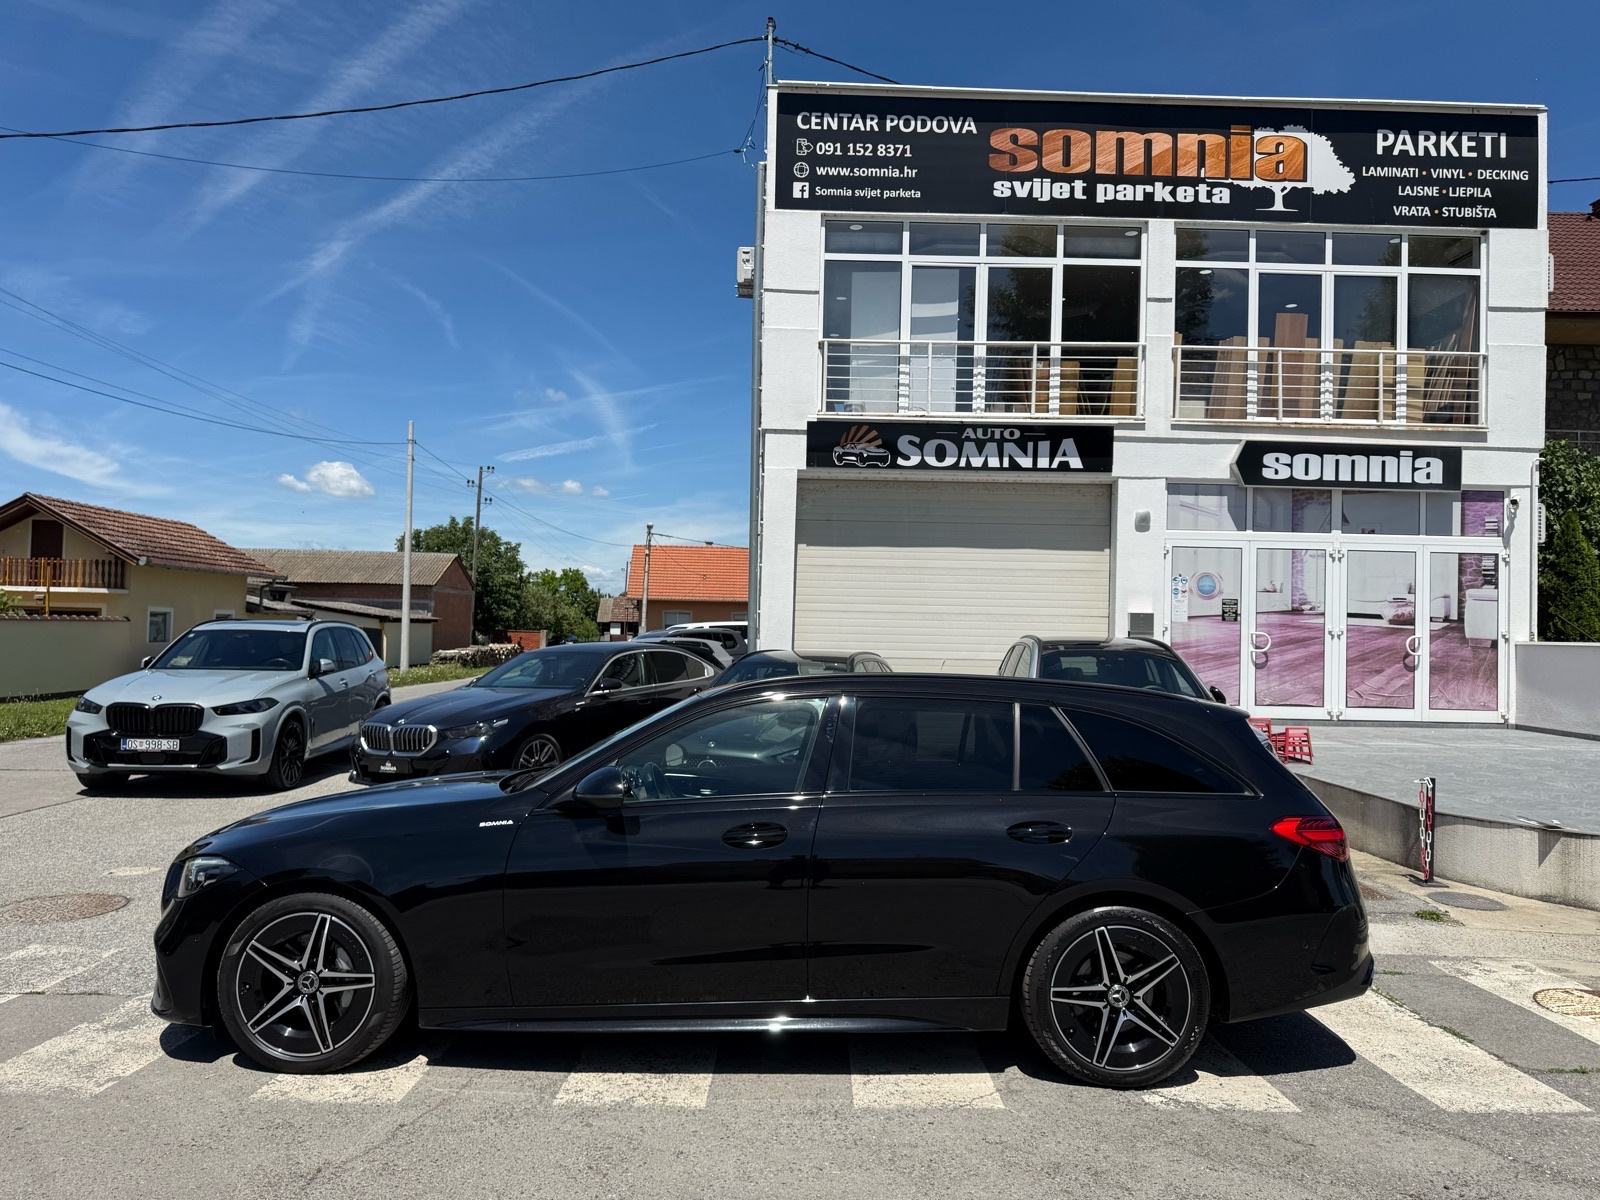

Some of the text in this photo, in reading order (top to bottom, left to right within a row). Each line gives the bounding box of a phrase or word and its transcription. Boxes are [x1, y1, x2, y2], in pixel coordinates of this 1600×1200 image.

[796, 111, 978, 135] CENTAR PODOVA
[815, 141, 913, 158] 091 152 8371
[1376, 129, 1507, 159] PARKETI
[988, 124, 1308, 183] somnia
[815, 165, 918, 179] www.somnia.hr
[1362, 166, 1529, 181] LAMINATI VINYL DECKING
[815, 186, 921, 200] Somnia svijet parketa
[993, 177, 1231, 204] svijet parketa
[1398, 185, 1493, 198] LAJSNE LJEPILA
[1392, 204, 1497, 219] VRATA STUBIŠTA
[961, 427, 1021, 440] AUTO
[896, 434, 1084, 469] SOMNIA
[1261, 450, 1444, 485] somnia
